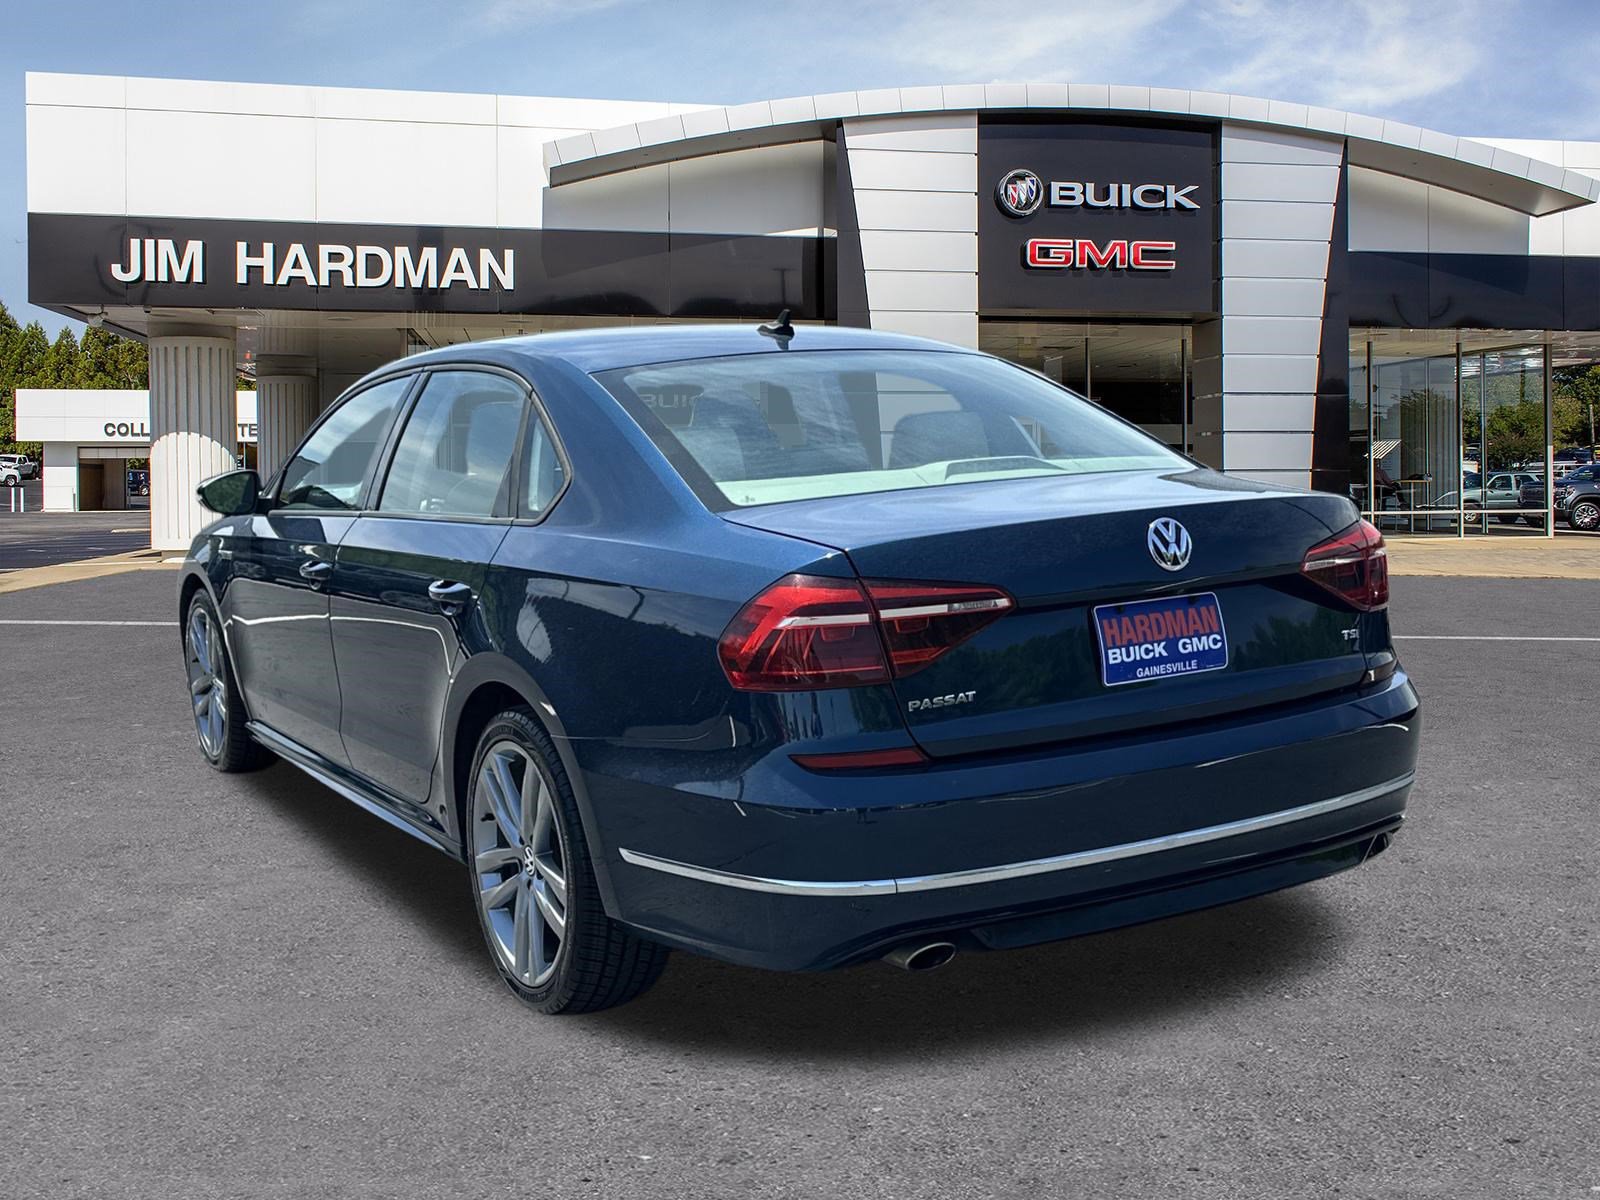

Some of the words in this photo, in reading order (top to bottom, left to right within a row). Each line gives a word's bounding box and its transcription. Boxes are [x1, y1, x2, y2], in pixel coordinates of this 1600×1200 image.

[1050, 181, 1200, 209] BUICK
[111, 238, 204, 284] JIM
[236, 241, 515, 291] HARDMAN
[1026, 238, 1176, 270] GMC
[1103, 606, 1218, 647] HARDMAN
[1107, 642, 1168, 664] BUICK
[1178, 633, 1222, 654] GMC
[1136, 660, 1198, 677] GAINESVILLE
[908, 690, 976, 712] PASSAT
